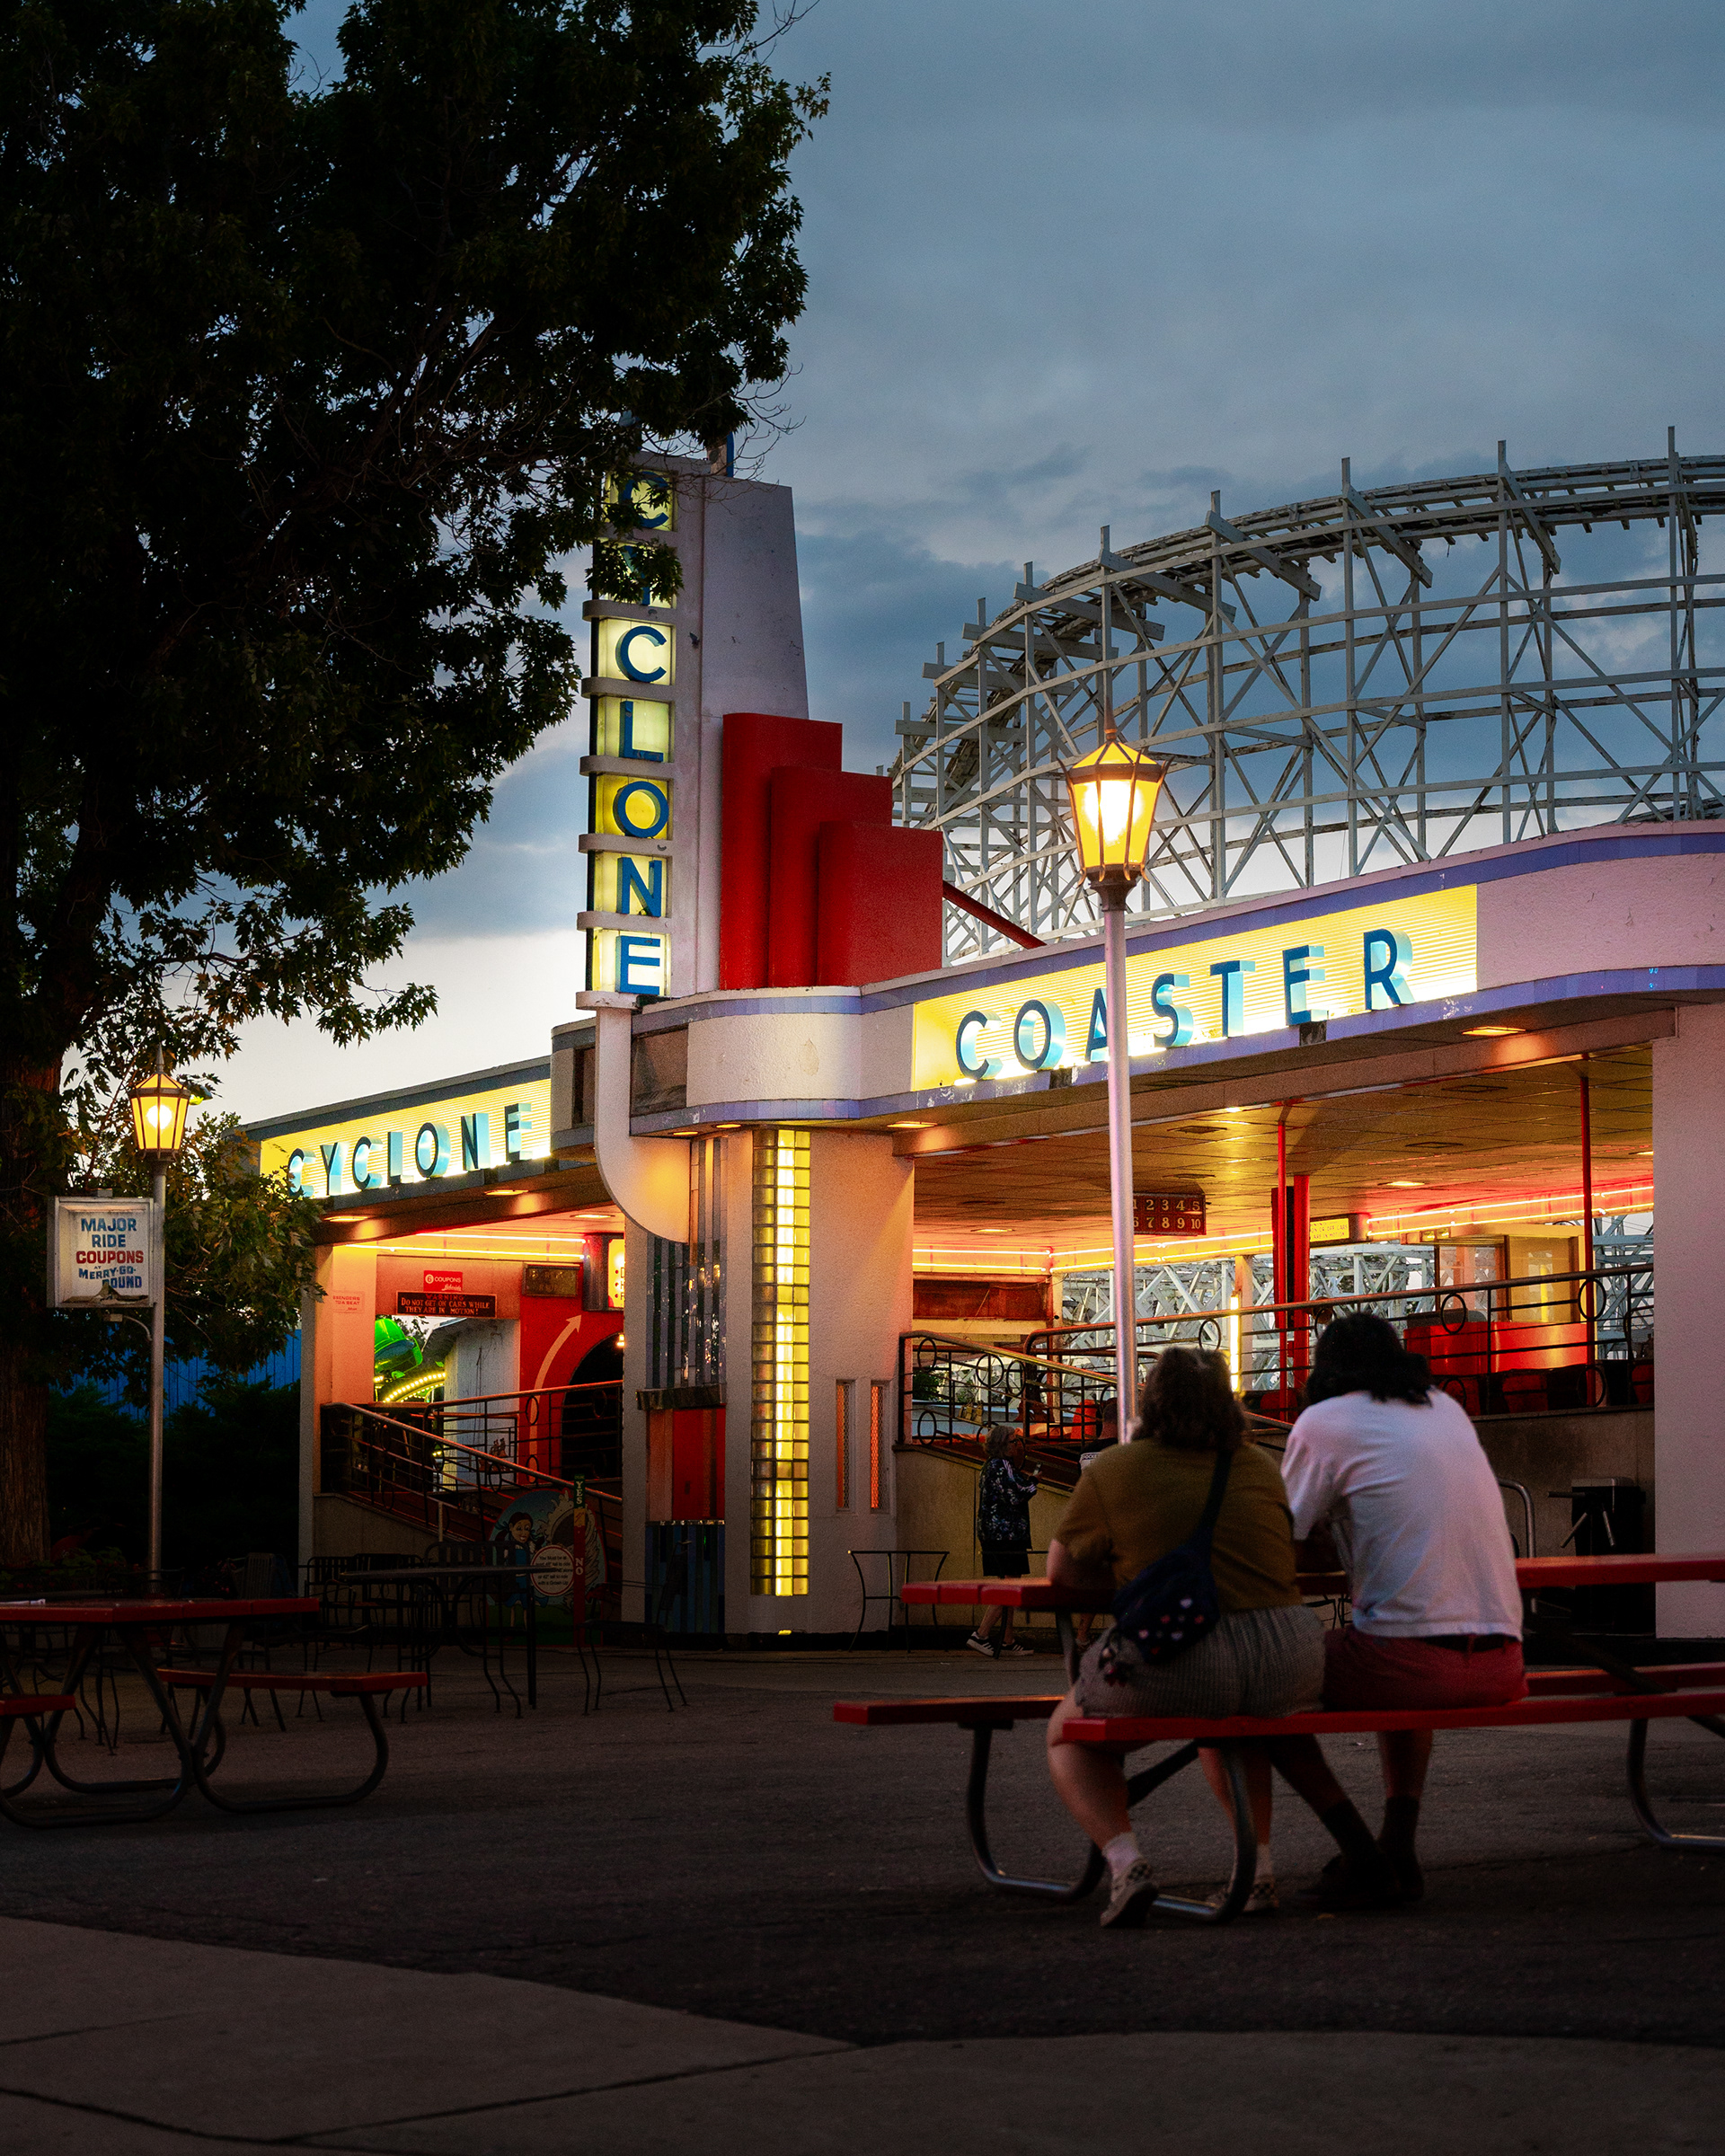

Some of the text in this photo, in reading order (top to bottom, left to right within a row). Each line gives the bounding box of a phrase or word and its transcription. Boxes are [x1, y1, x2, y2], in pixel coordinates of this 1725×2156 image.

[956, 928, 1415, 1080] COASTER
[288, 1103, 532, 1198] CYCLONE
[1132, 1199, 1200, 1211] 1 2 3 4 5
[81, 1218, 137, 1232] MAJOR
[1133, 1217, 1201, 1229] 6 7 8 9 10
[92, 1234, 126, 1248] RIDE
[76, 1250, 144, 1264] COUPONS
[450, 1307, 478, 1315] MOTION!
[468, 1301, 490, 1309] WHILE
[575, 1481, 584, 1505] YES
[575, 1558, 584, 1575] NO
